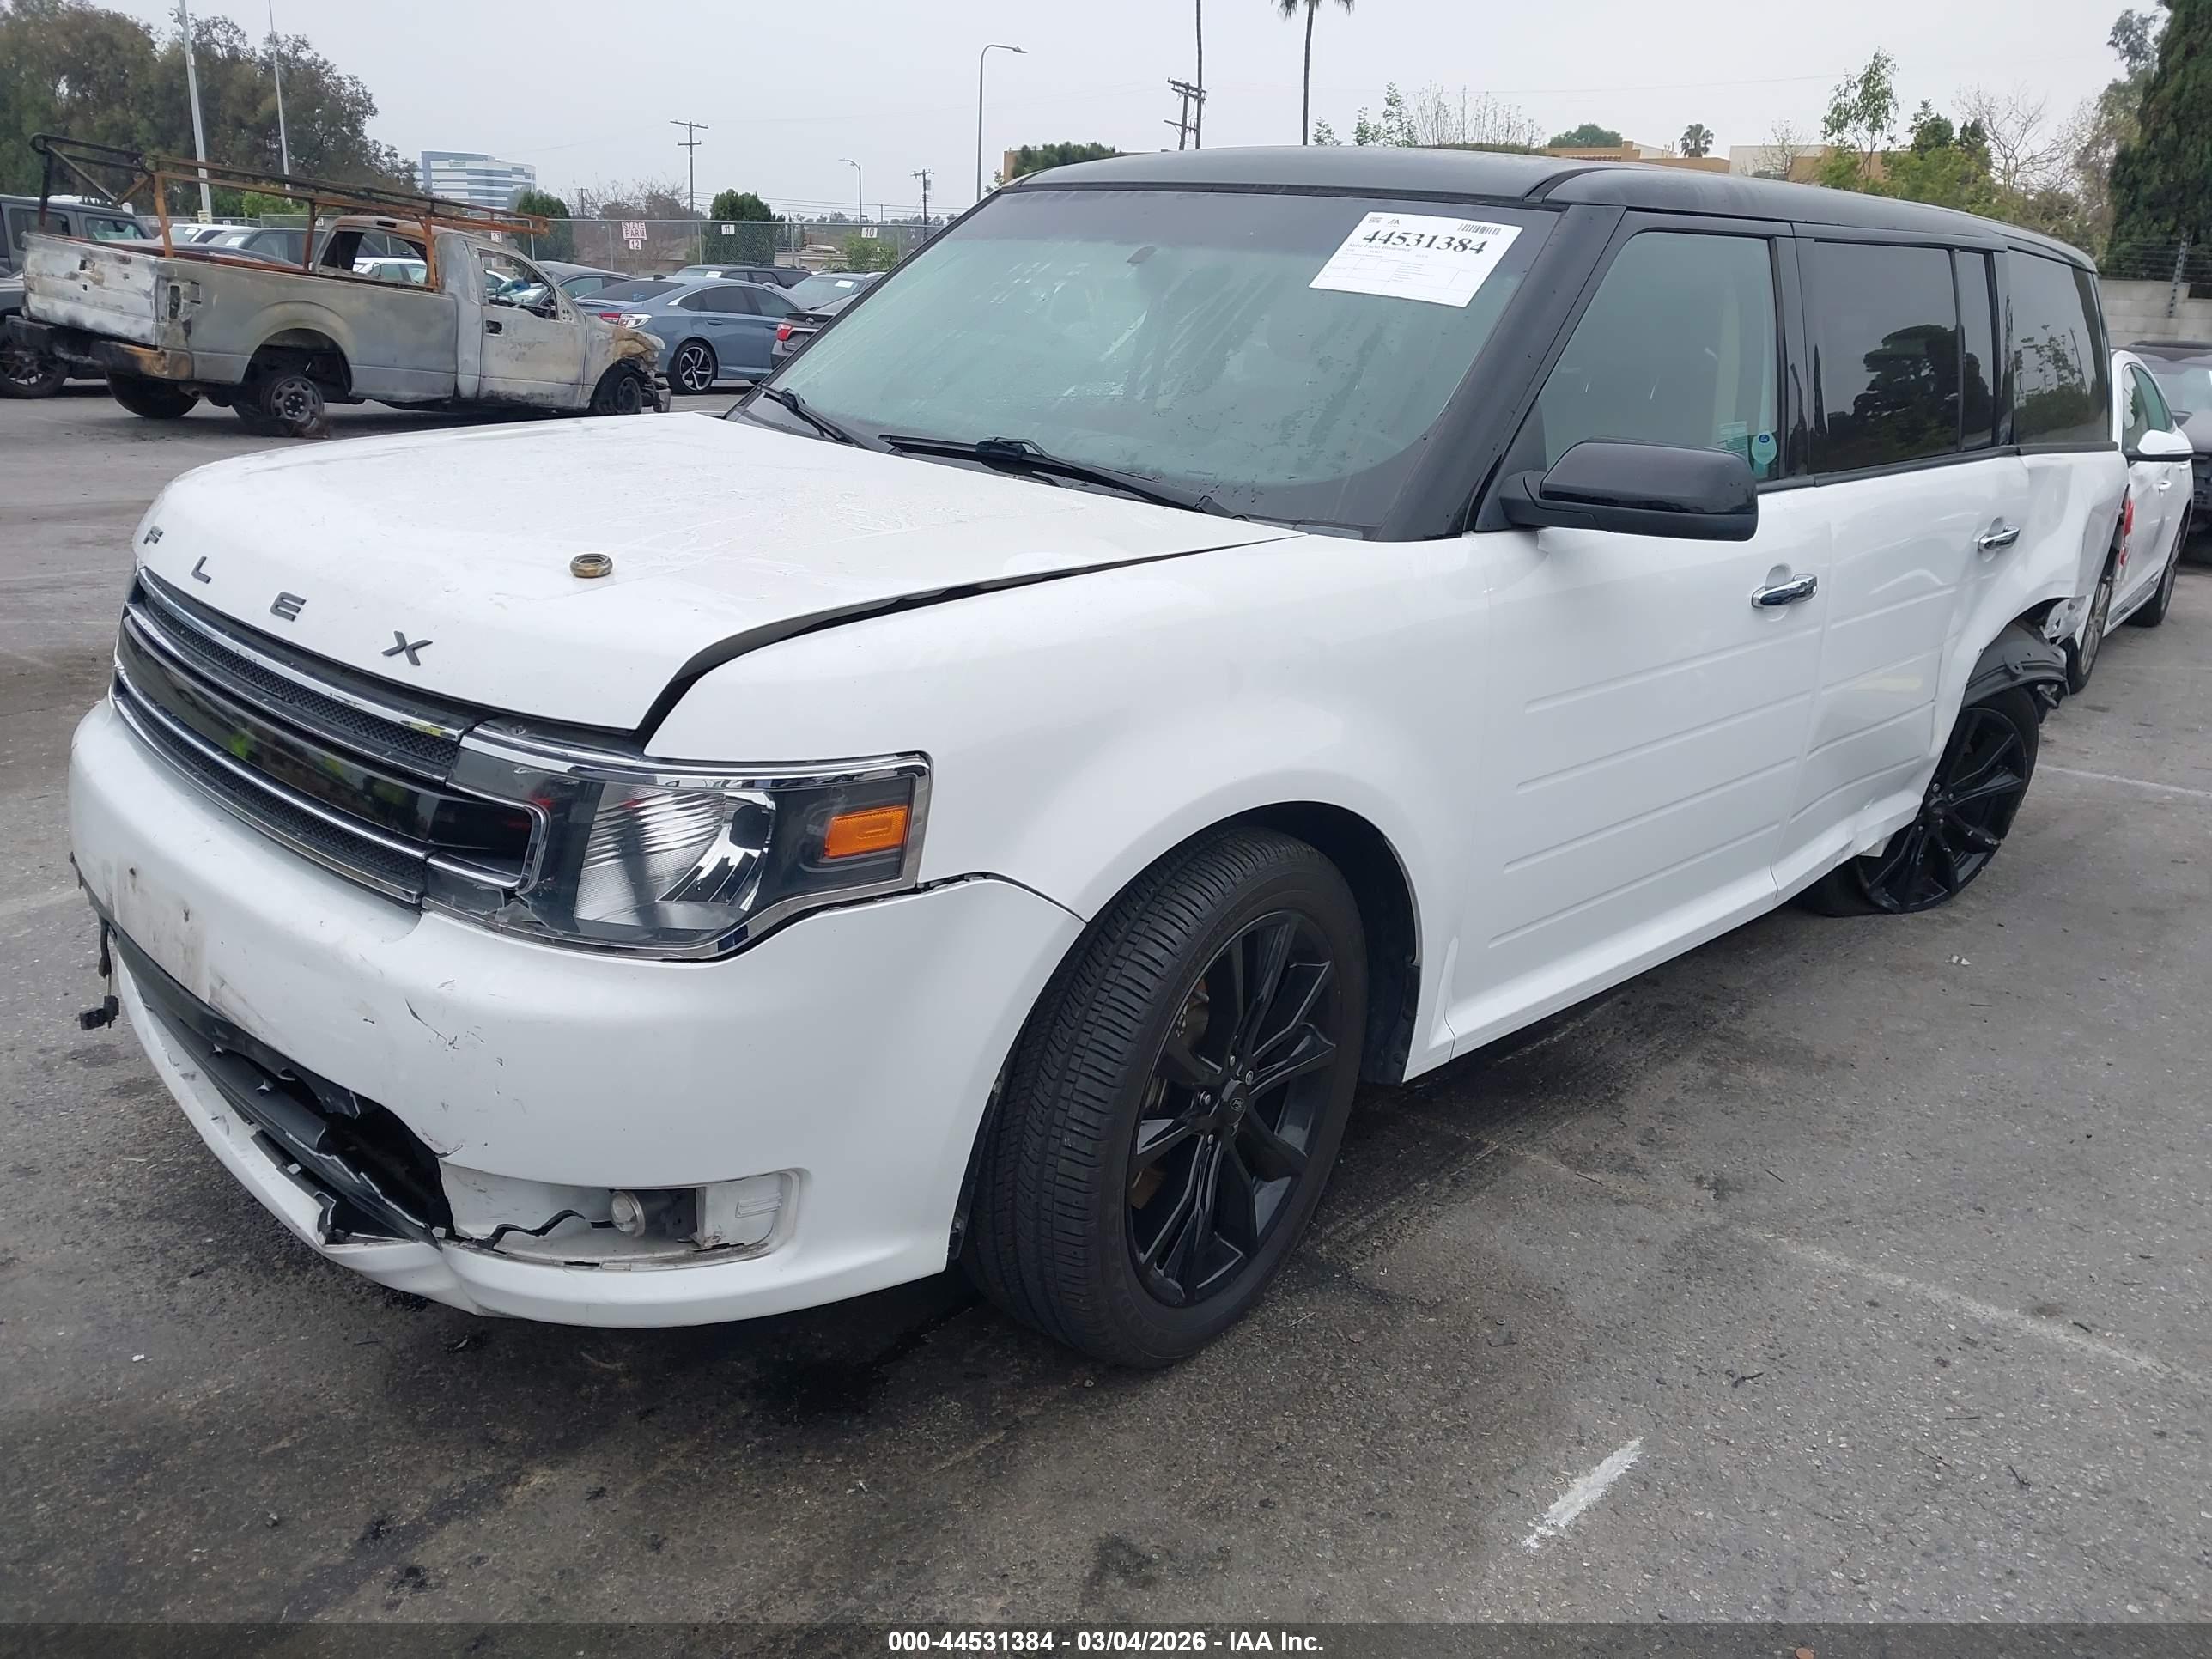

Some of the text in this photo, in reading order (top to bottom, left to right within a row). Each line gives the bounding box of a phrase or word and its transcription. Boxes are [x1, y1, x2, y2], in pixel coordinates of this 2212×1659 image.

[493, 233, 501, 241] 13
[866, 228, 875, 237] 10
[631, 240, 640, 249] 12
[1363, 230, 1488, 254] 44531384
[142, 525, 433, 666] FLEX
